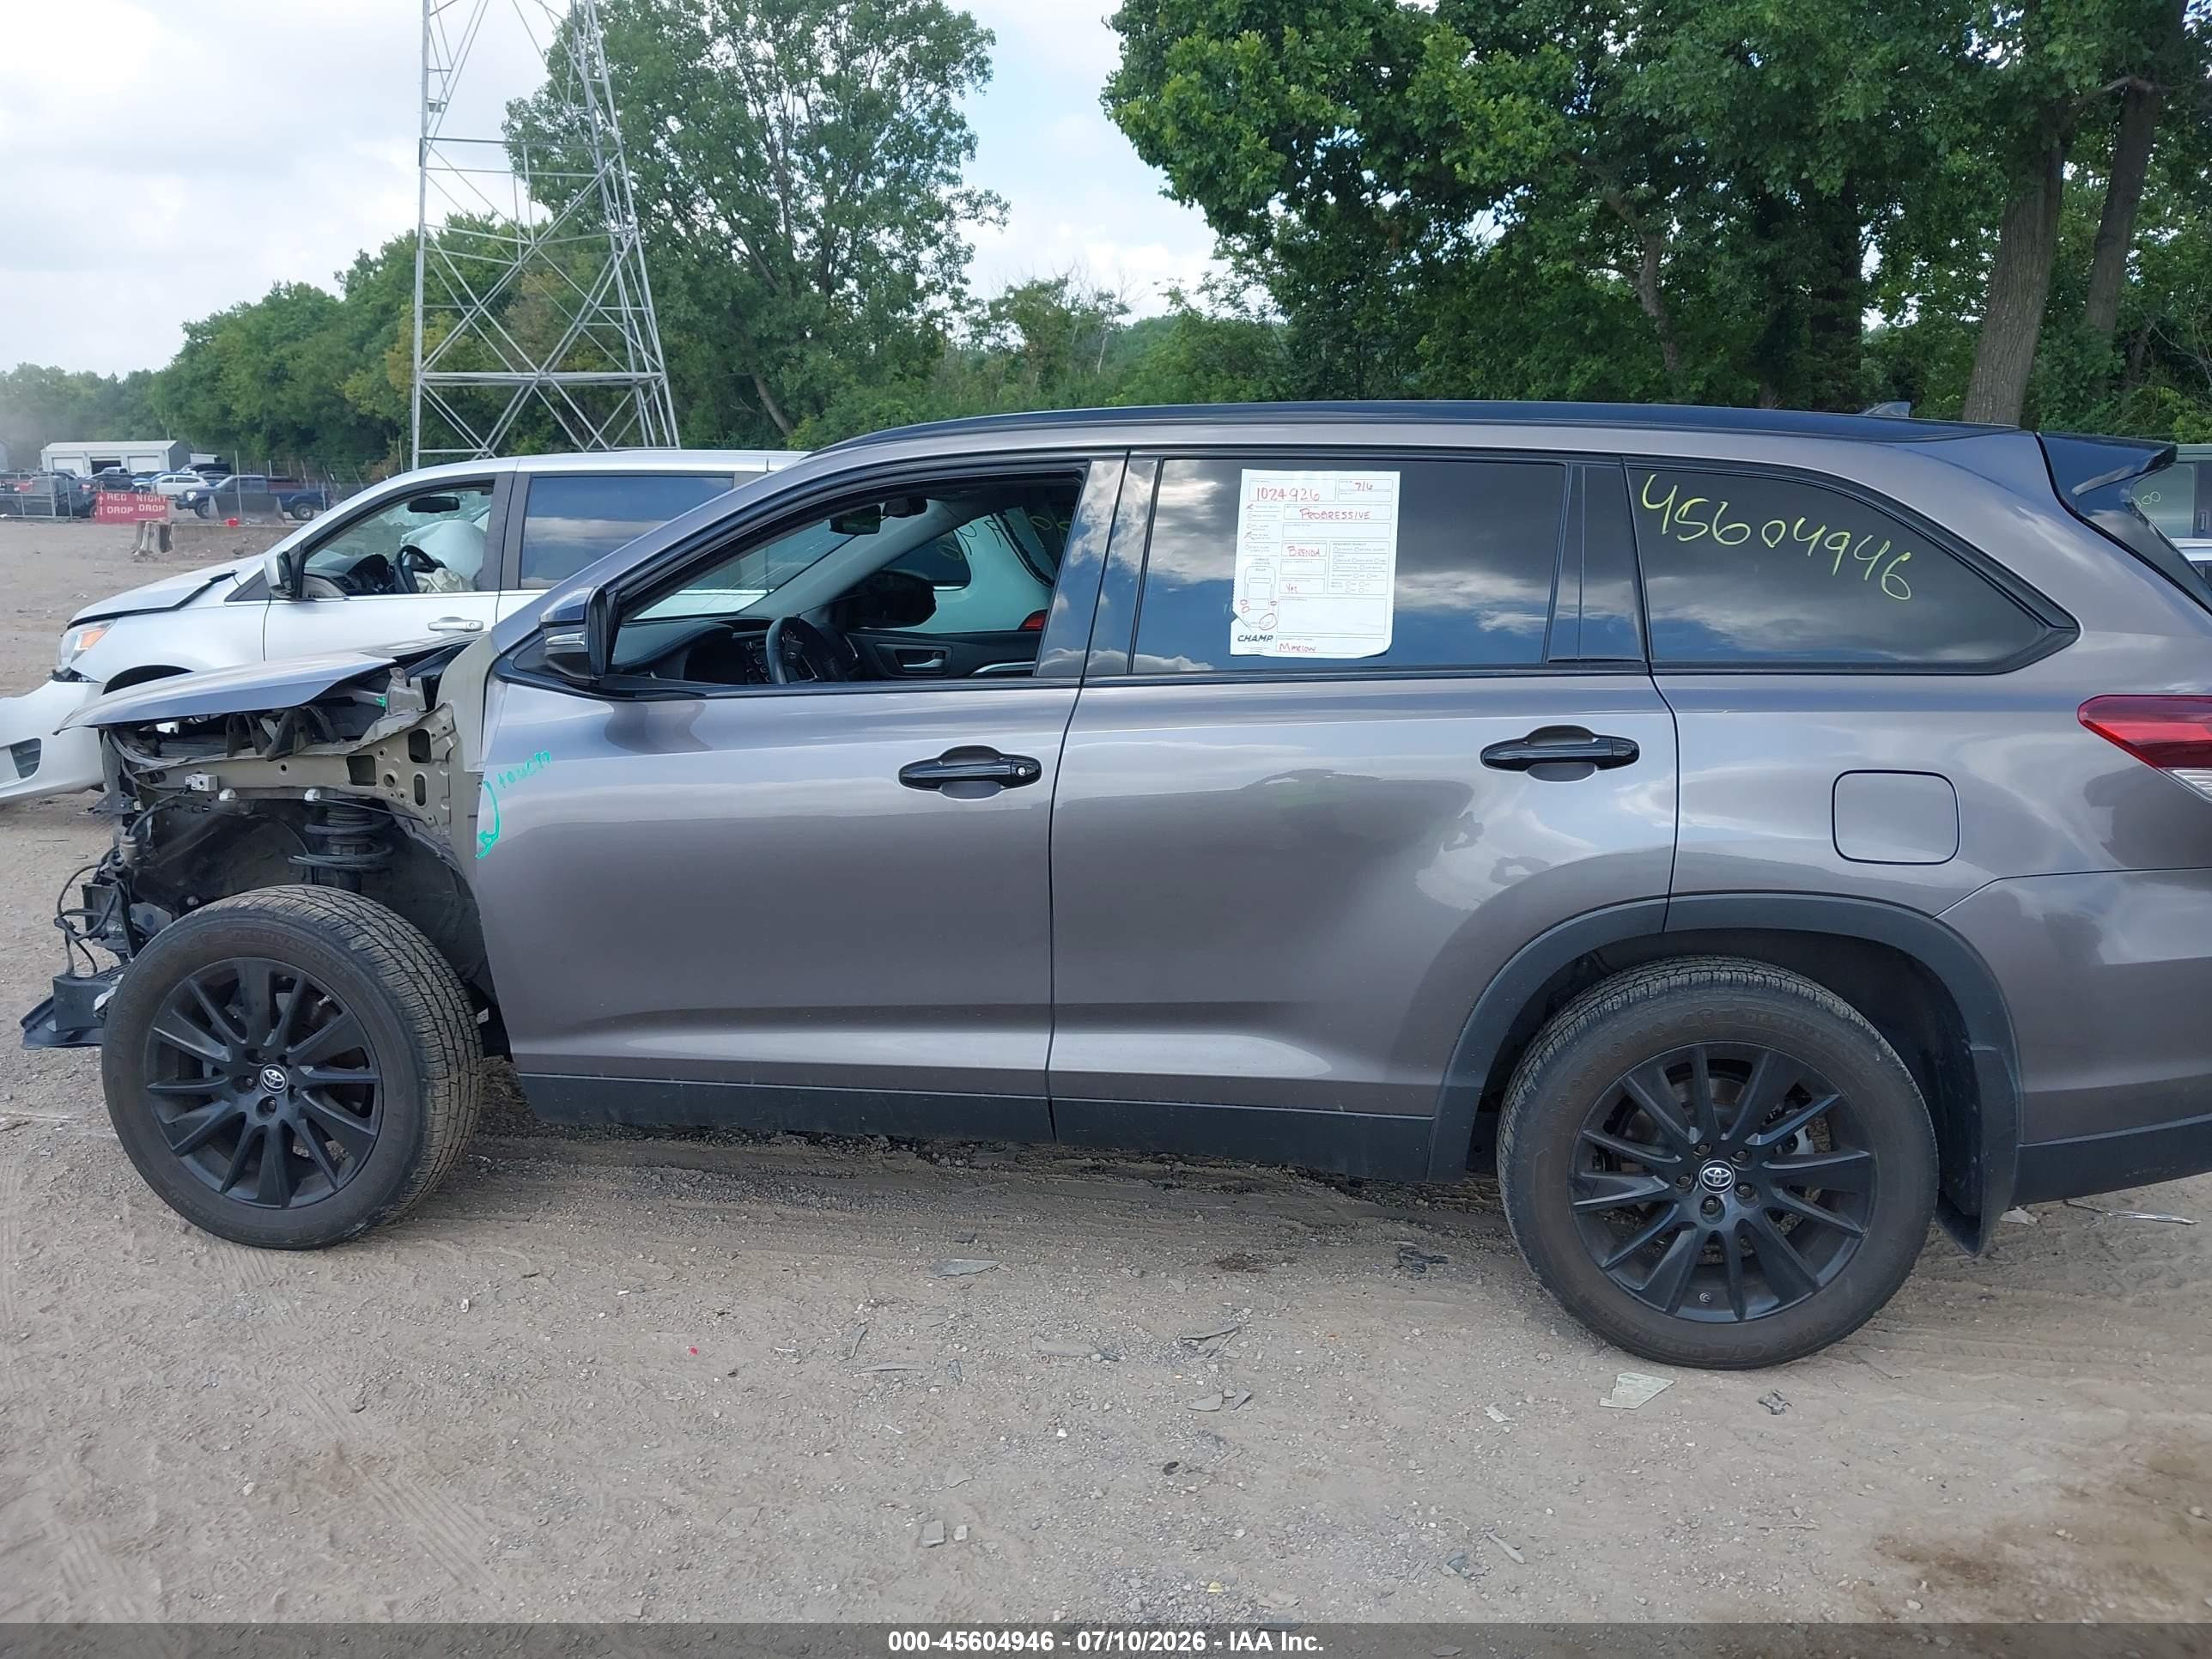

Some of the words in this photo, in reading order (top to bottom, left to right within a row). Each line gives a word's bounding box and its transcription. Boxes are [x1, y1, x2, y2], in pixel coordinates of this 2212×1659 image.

[1354, 481, 1374, 492] 7/6
[106, 493, 127, 501] RED
[136, 494, 167, 502] NIGHT
[1255, 486, 1322, 502] 1024926
[106, 506, 134, 515] DROP
[138, 503, 166, 513] DROP
[1641, 473, 1912, 601] 45604946
[1237, 634, 1274, 643] CHAMP
